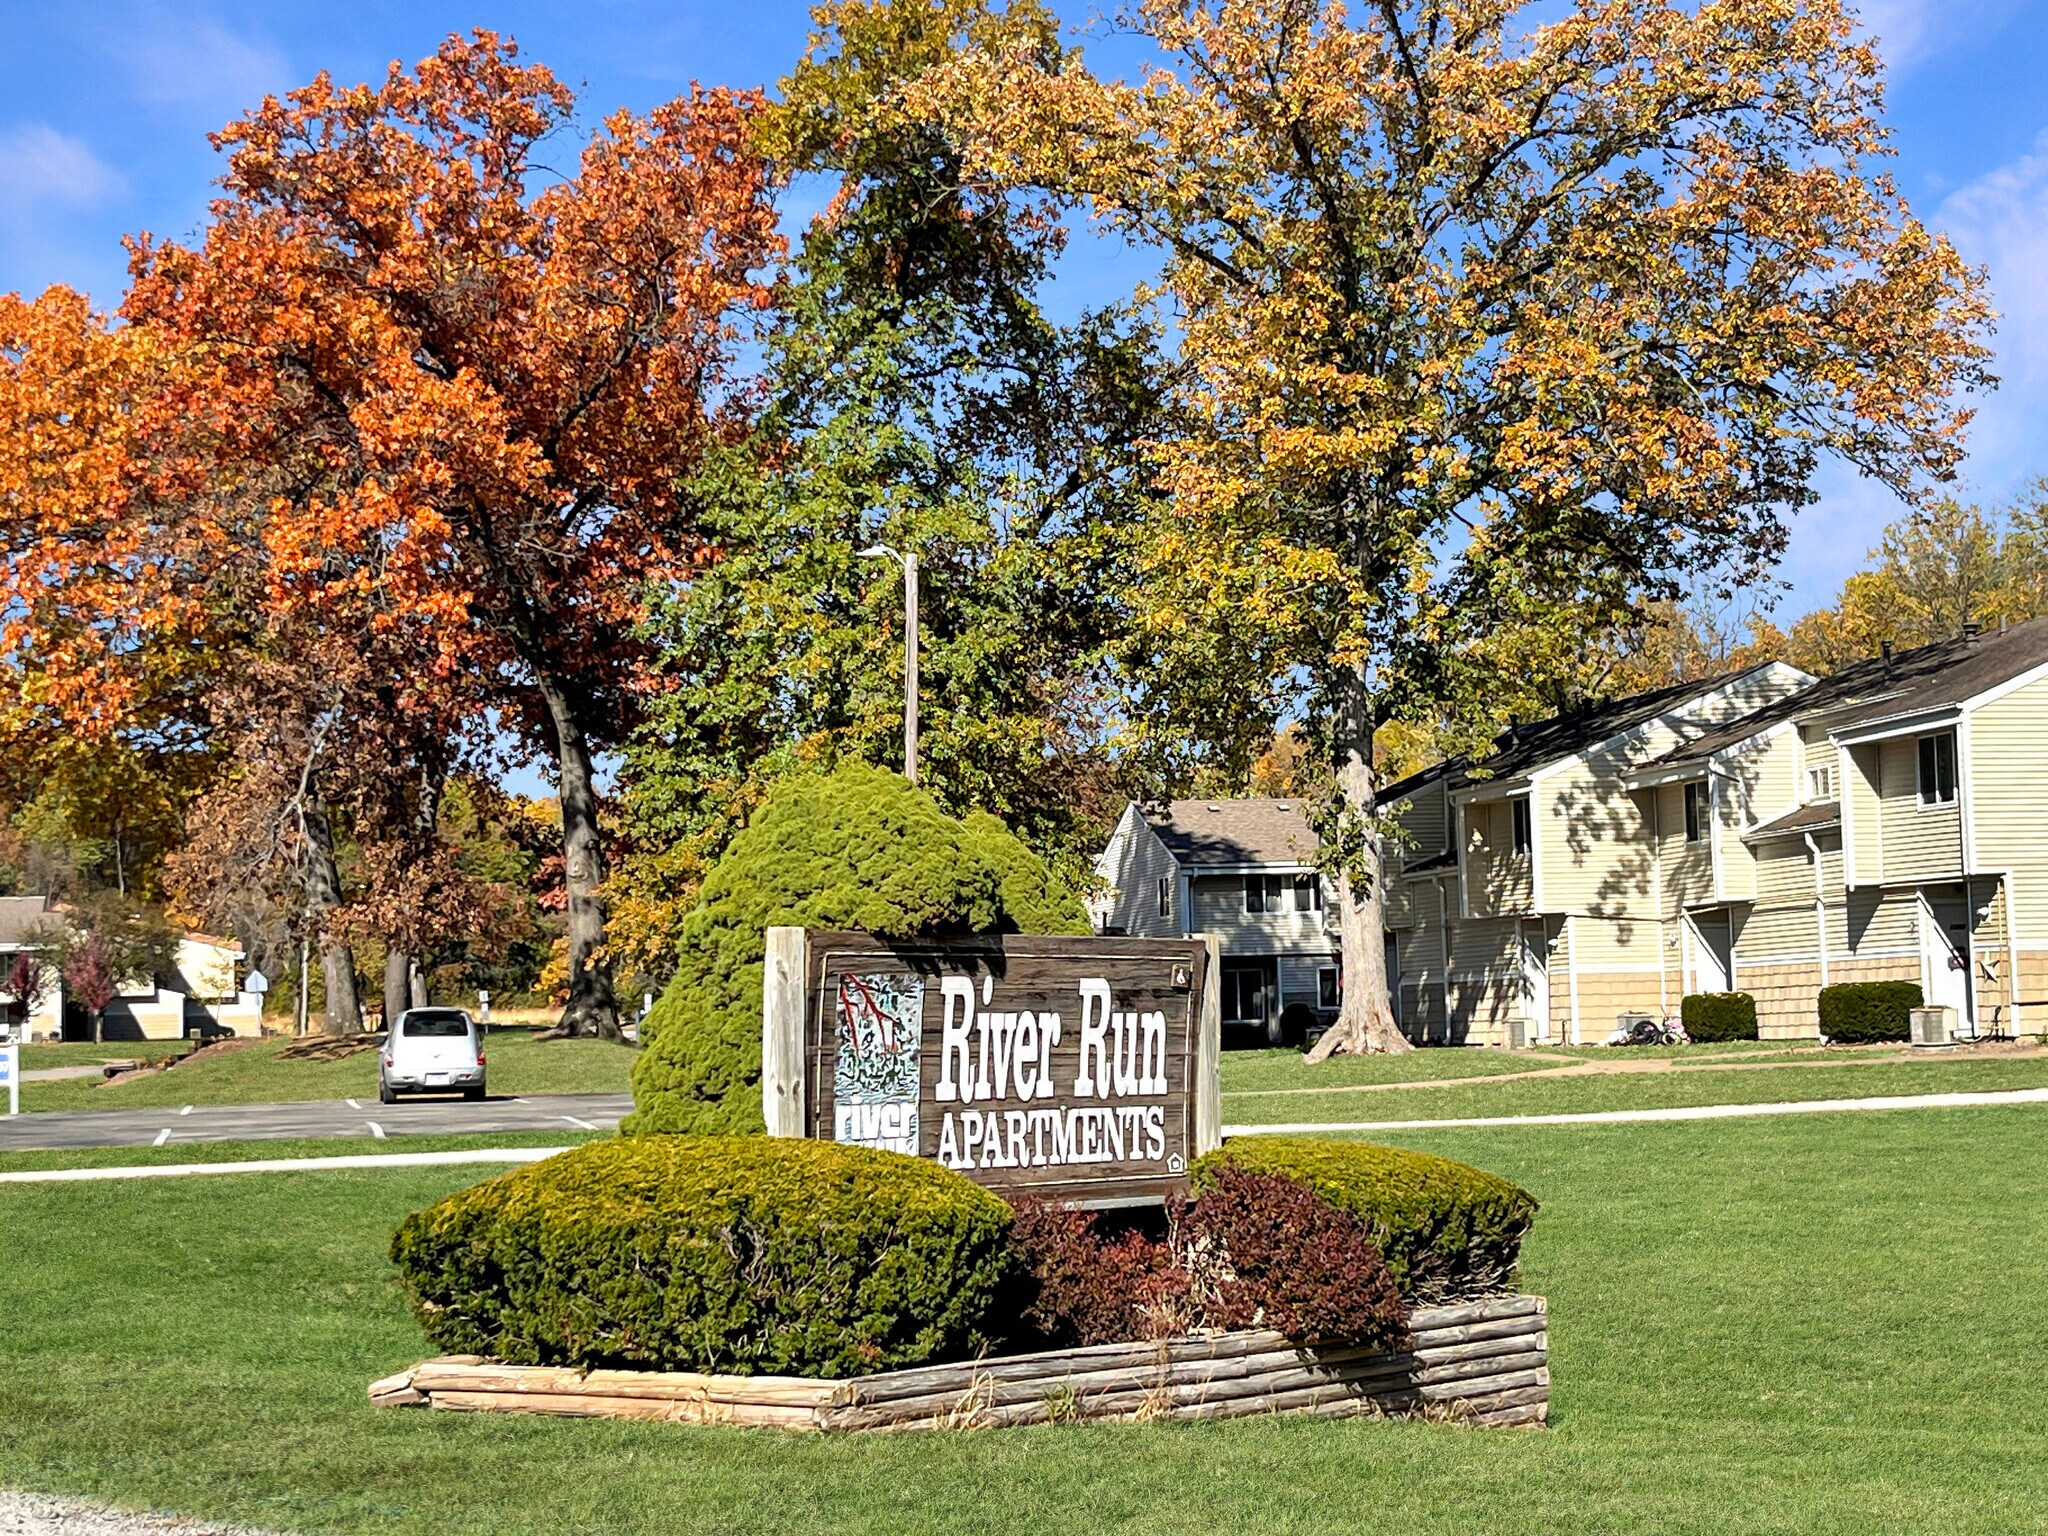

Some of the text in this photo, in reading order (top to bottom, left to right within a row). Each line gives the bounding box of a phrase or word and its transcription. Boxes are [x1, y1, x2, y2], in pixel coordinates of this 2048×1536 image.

[935, 975, 1168, 1104] River Run
[835, 1095, 917, 1141] river
[937, 1105, 1165, 1170] APARTMENTS
